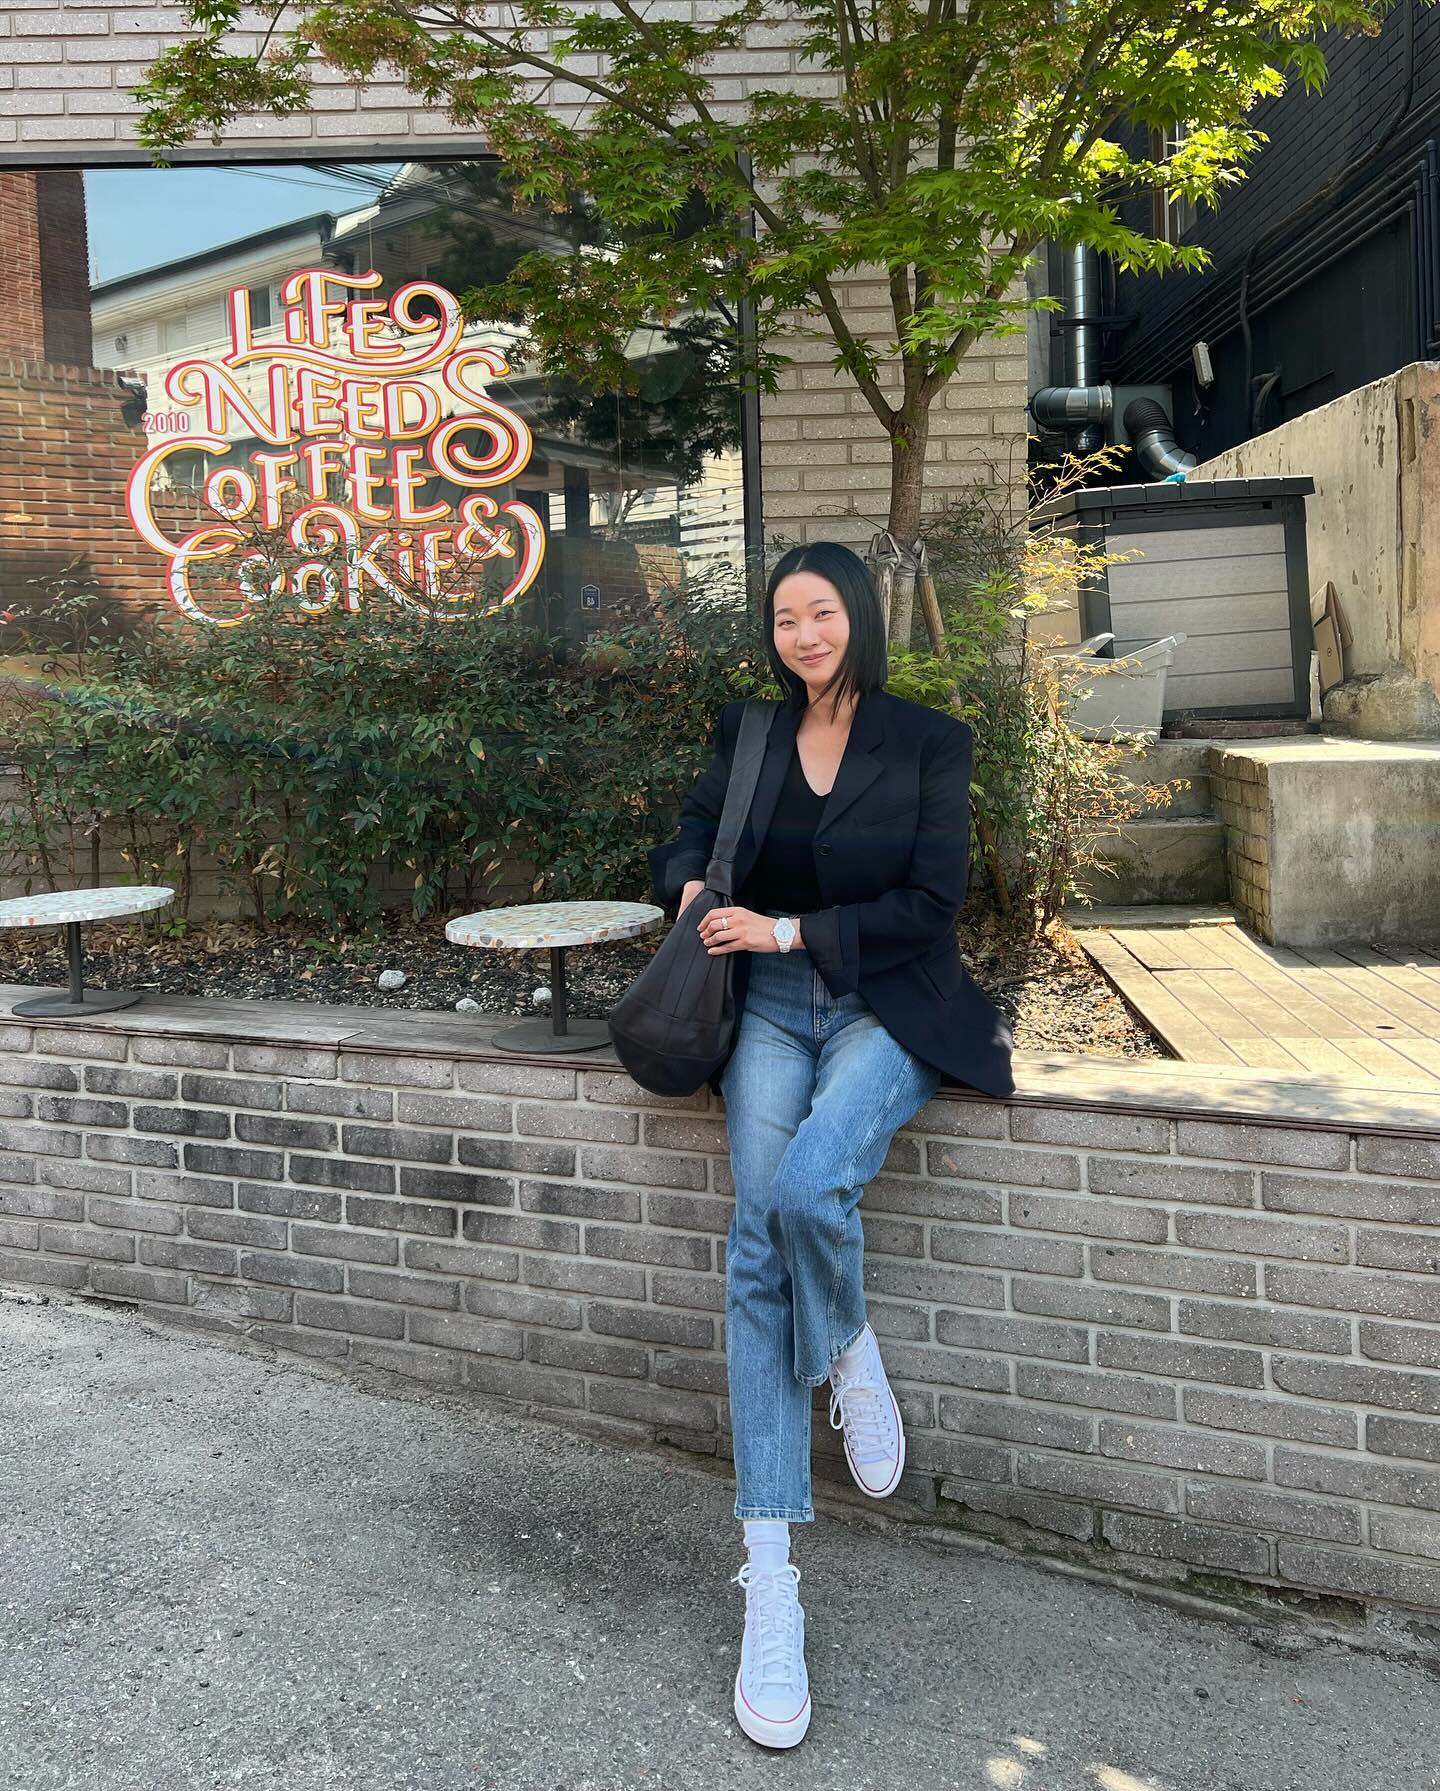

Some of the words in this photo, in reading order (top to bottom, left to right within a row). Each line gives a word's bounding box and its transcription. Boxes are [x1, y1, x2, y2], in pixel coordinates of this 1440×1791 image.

[141, 411, 191, 433] 2010
[165, 348, 533, 488] NEEDS
[125, 436, 452, 557] COFFEE
[454, 493, 516, 559] &
